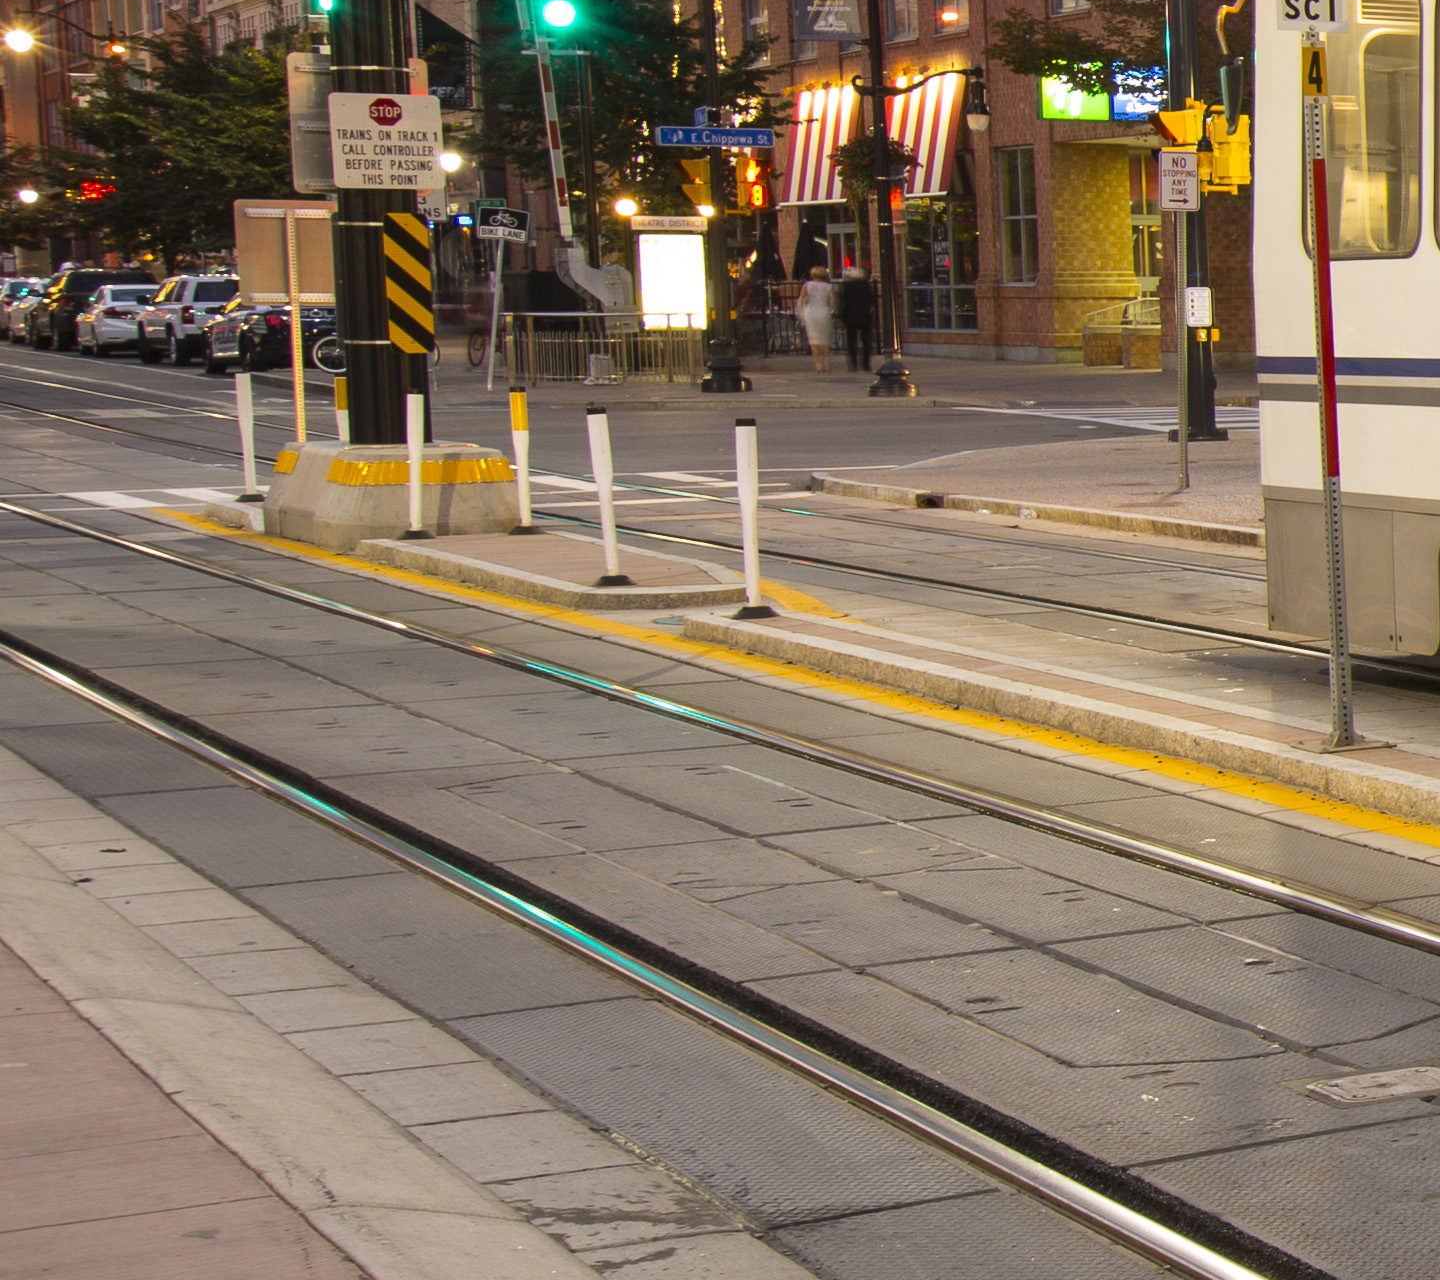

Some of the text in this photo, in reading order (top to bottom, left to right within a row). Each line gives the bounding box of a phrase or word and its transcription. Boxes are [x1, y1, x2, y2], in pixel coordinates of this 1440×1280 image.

[1308, 50, 1323, 93] 4
[370, 106, 401, 118] STOP
[336, 129, 438, 142] TRAINS ON TRACK 1
[702, 131, 753, 145] Chippewa
[341, 144, 434, 156] CALL CONTROLLER
[345, 159, 433, 171] BEFORE PASSING
[1172, 157, 1187, 168] NO
[361, 174, 418, 185] THIS POINT
[1171, 179, 1187, 187] ANY
[1171, 188, 1188, 196] TIME
[634, 219, 705, 228] THEATRE DISTRICT
[481, 227, 524, 239] BIKE LANE
